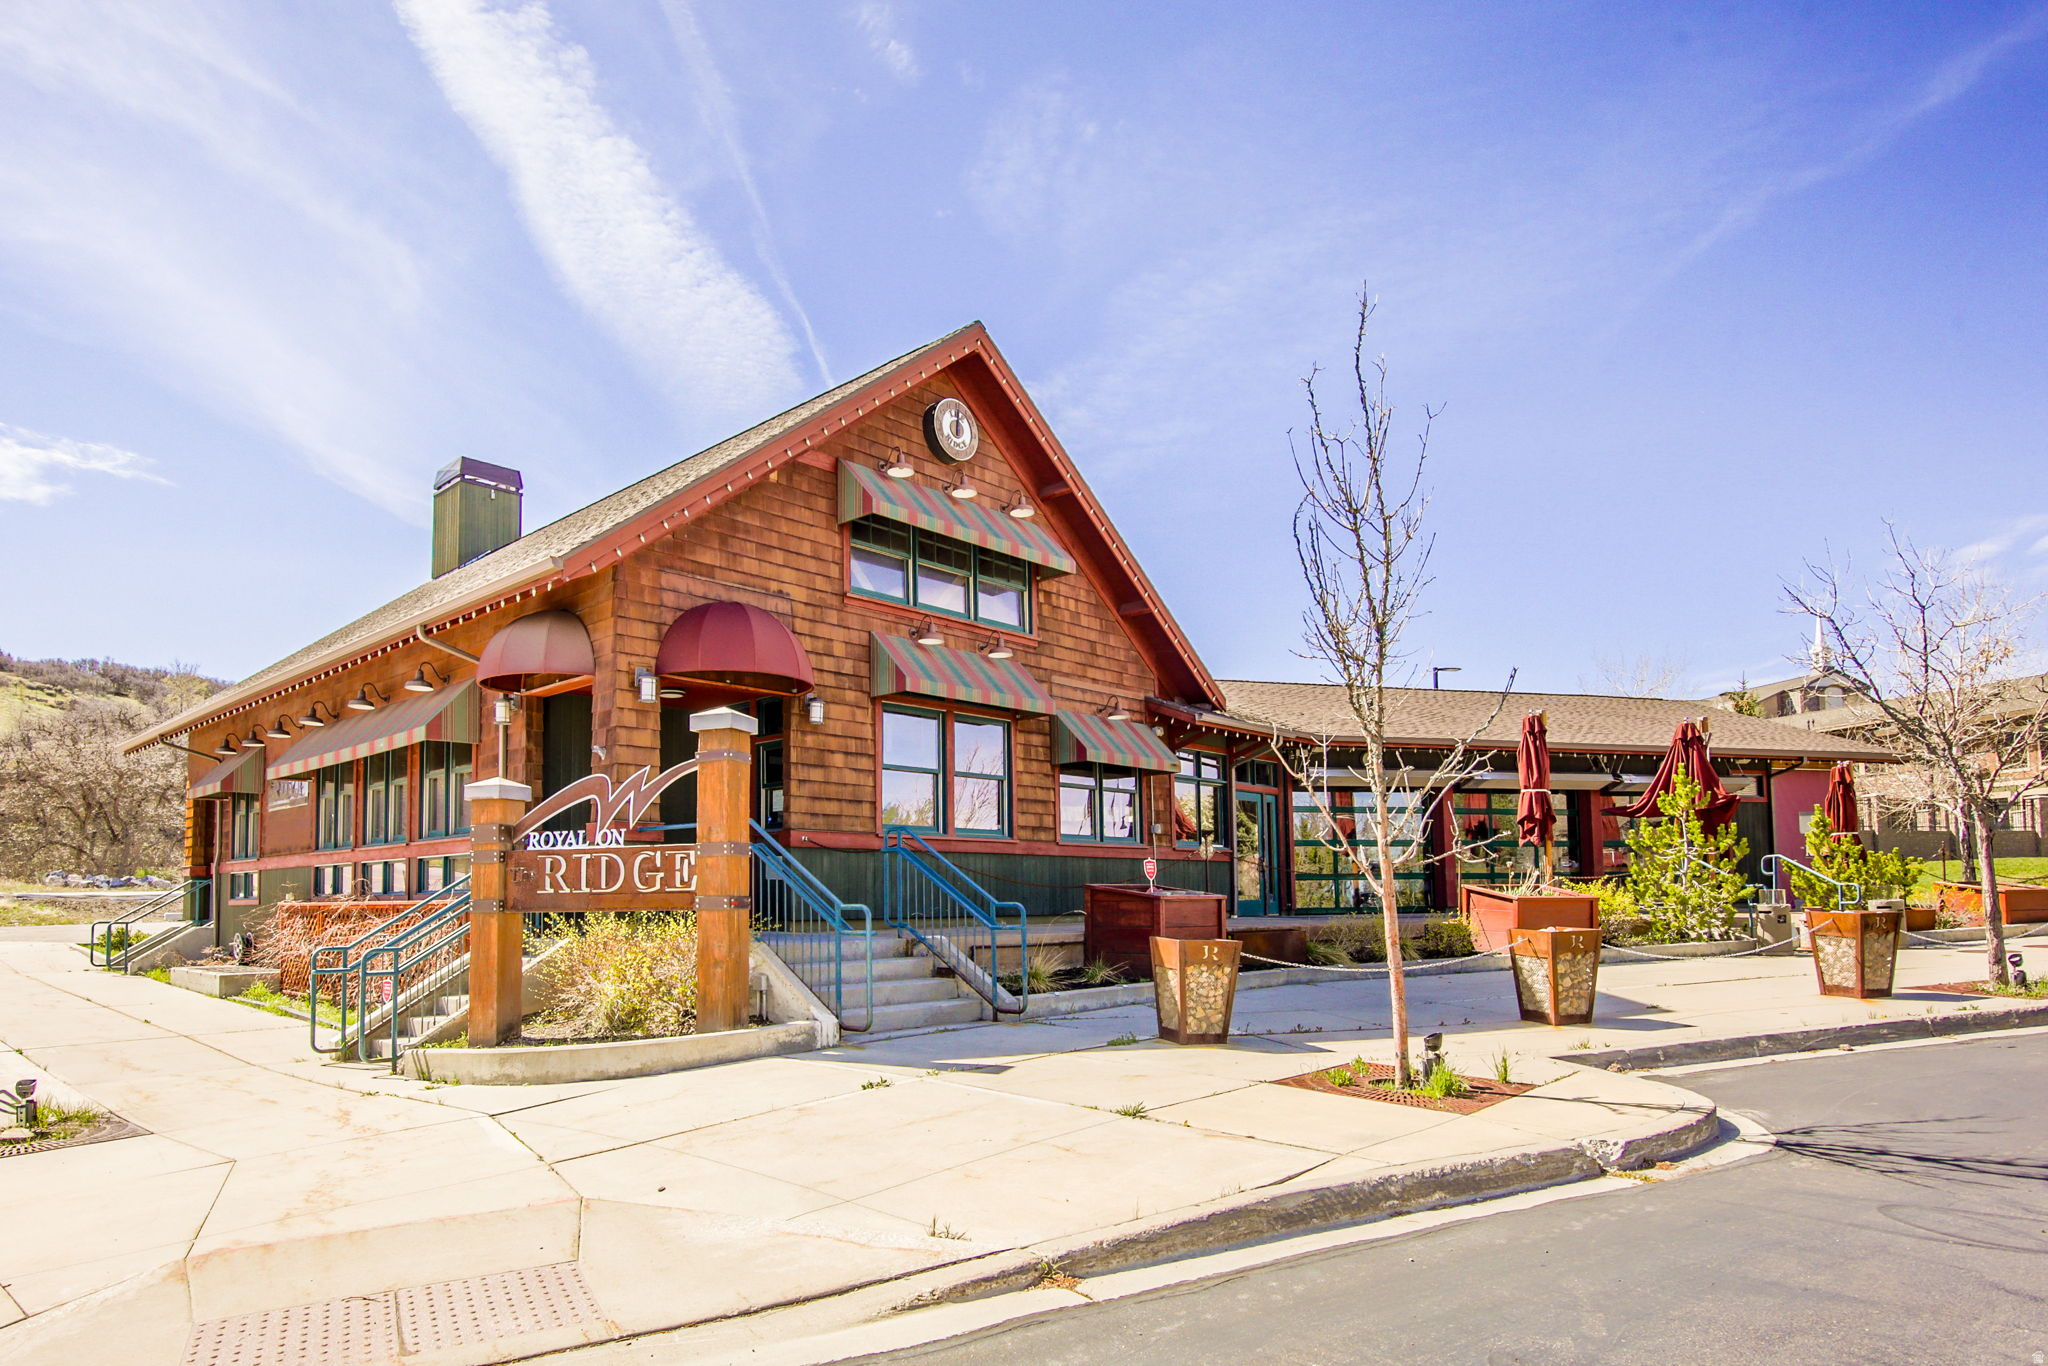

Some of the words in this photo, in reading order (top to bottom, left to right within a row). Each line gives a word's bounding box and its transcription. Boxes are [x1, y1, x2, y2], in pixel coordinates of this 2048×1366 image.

[527, 830, 590, 849] ROYAL
[597, 828, 627, 847] ON
[537, 850, 698, 893] RIDGE
